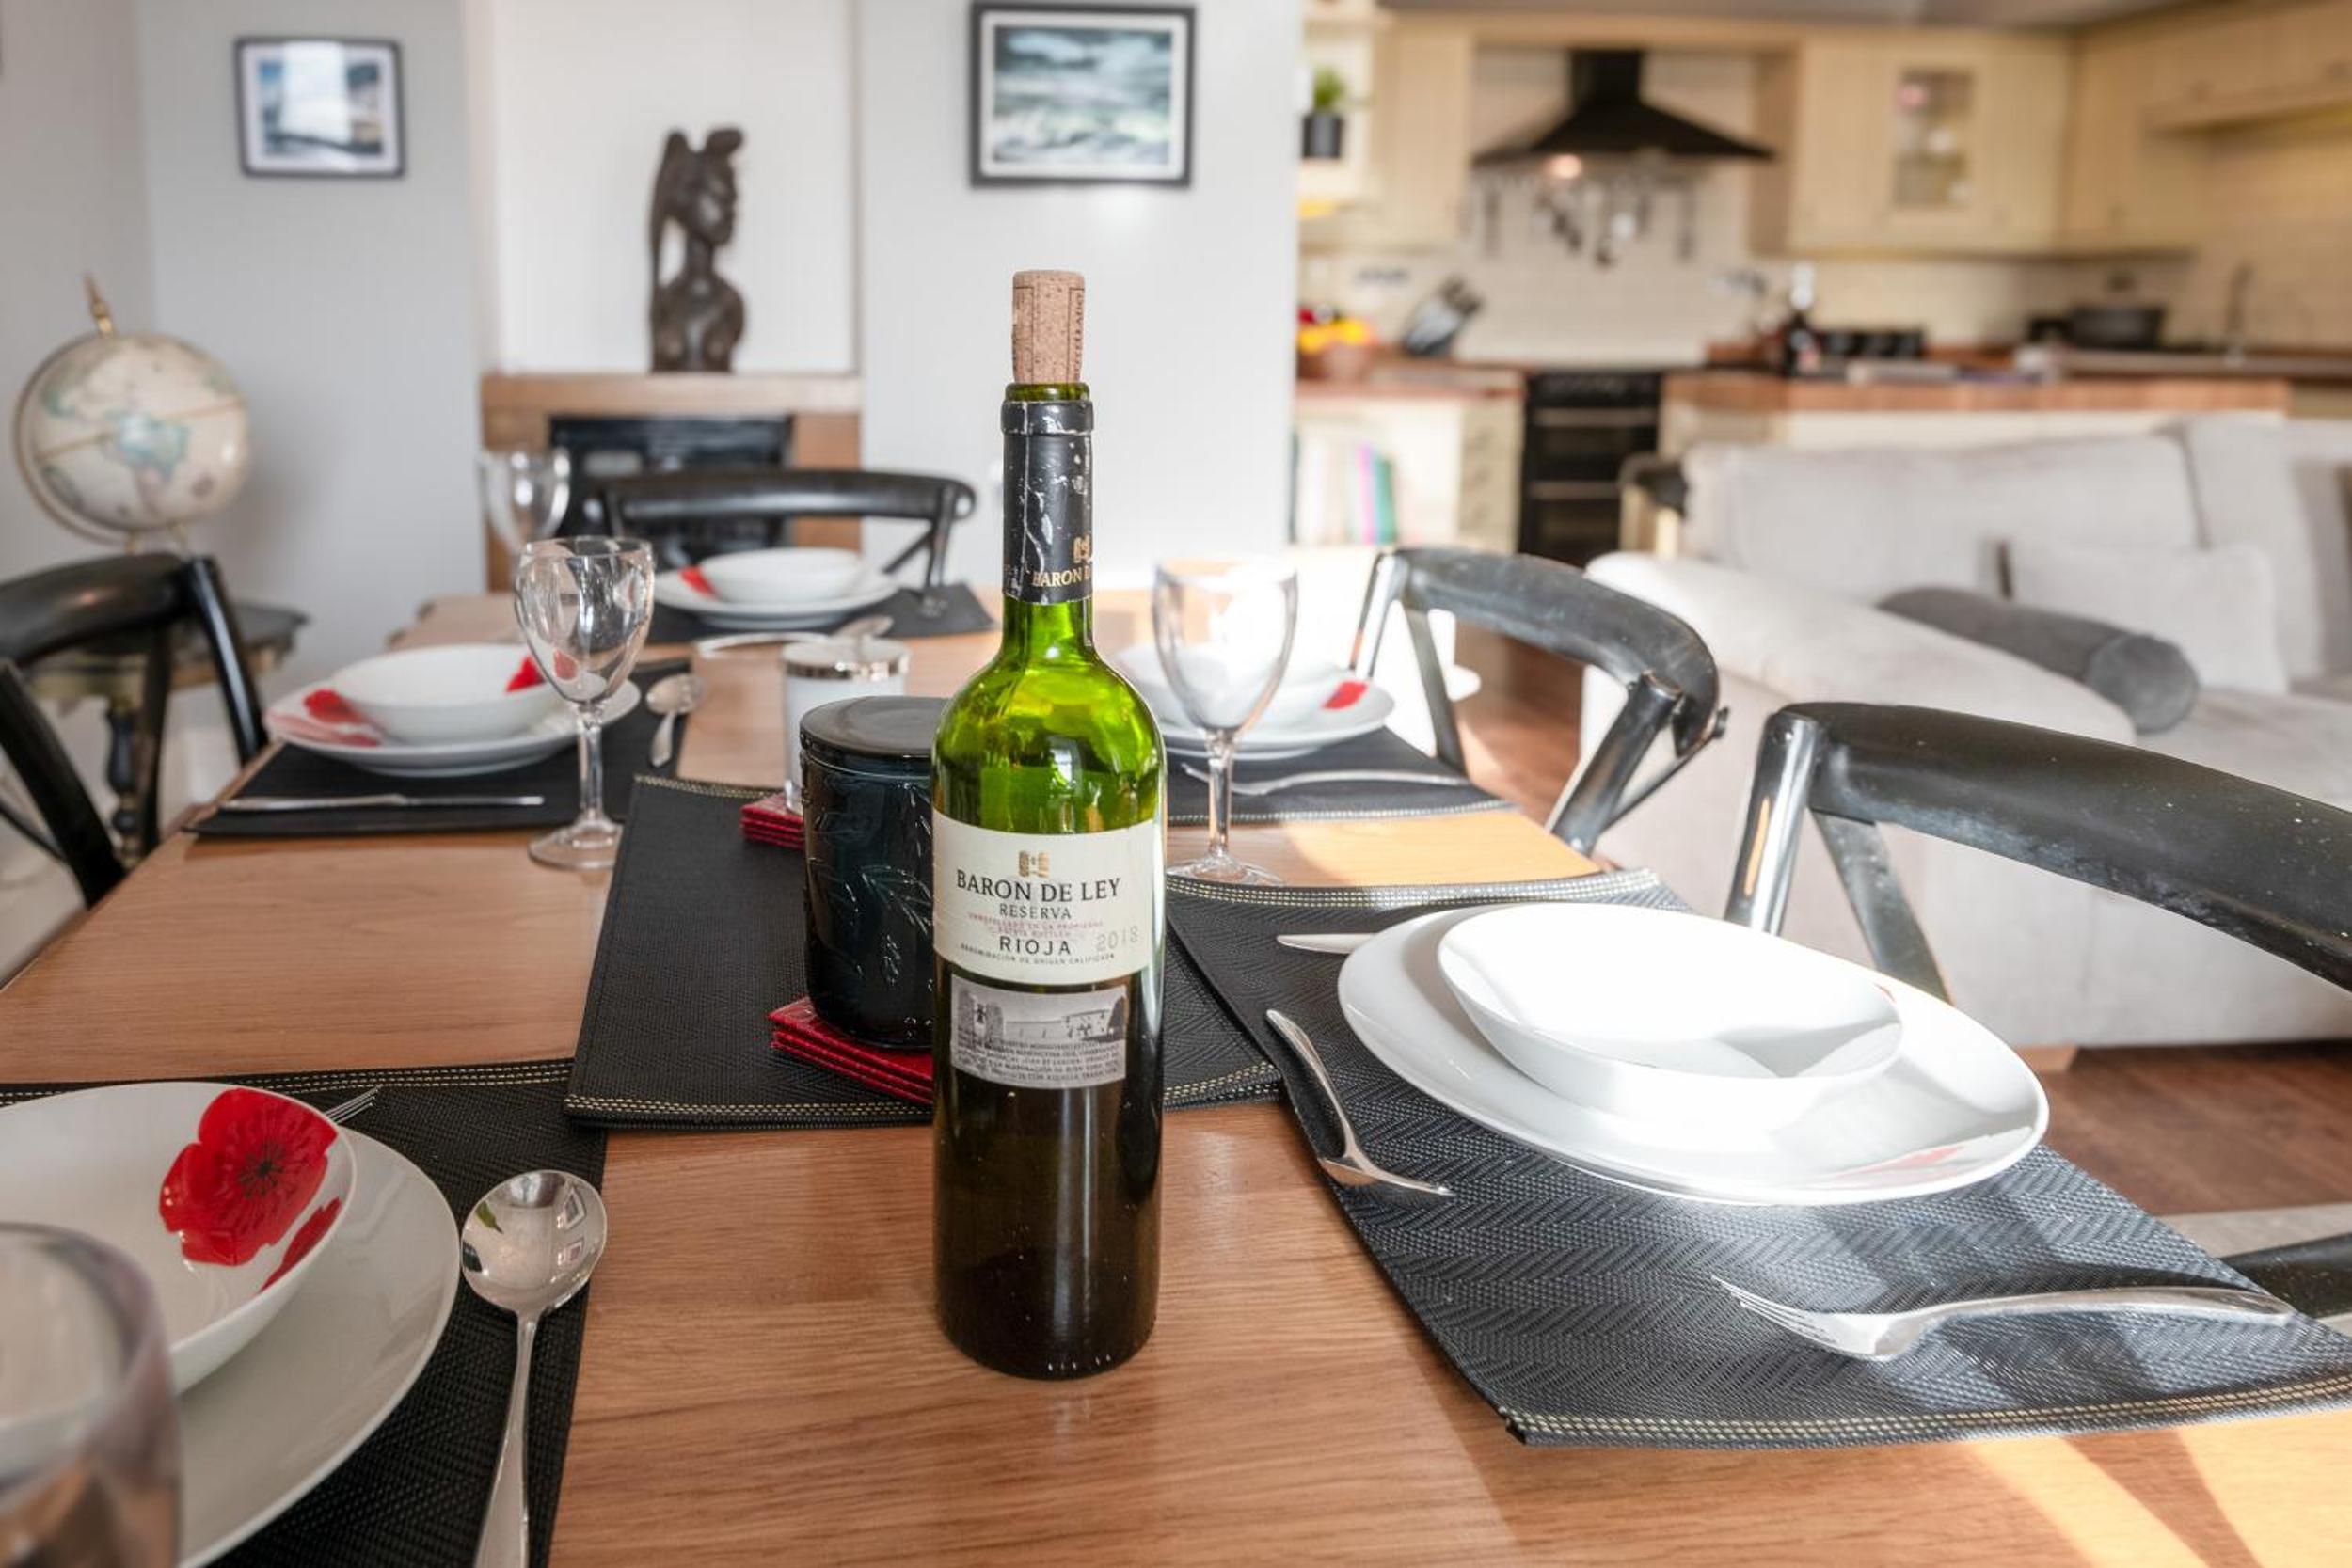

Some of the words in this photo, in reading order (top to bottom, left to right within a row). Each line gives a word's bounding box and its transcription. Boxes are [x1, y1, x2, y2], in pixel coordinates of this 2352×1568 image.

[1032, 566, 1082, 587] BARON
[957, 869, 1031, 901] BARON
[1041, 883, 1072, 902] DE
[1080, 877, 1121, 901] LEY
[999, 903, 1072, 920] RESERVA
[999, 936, 1072, 956] RIOJA
